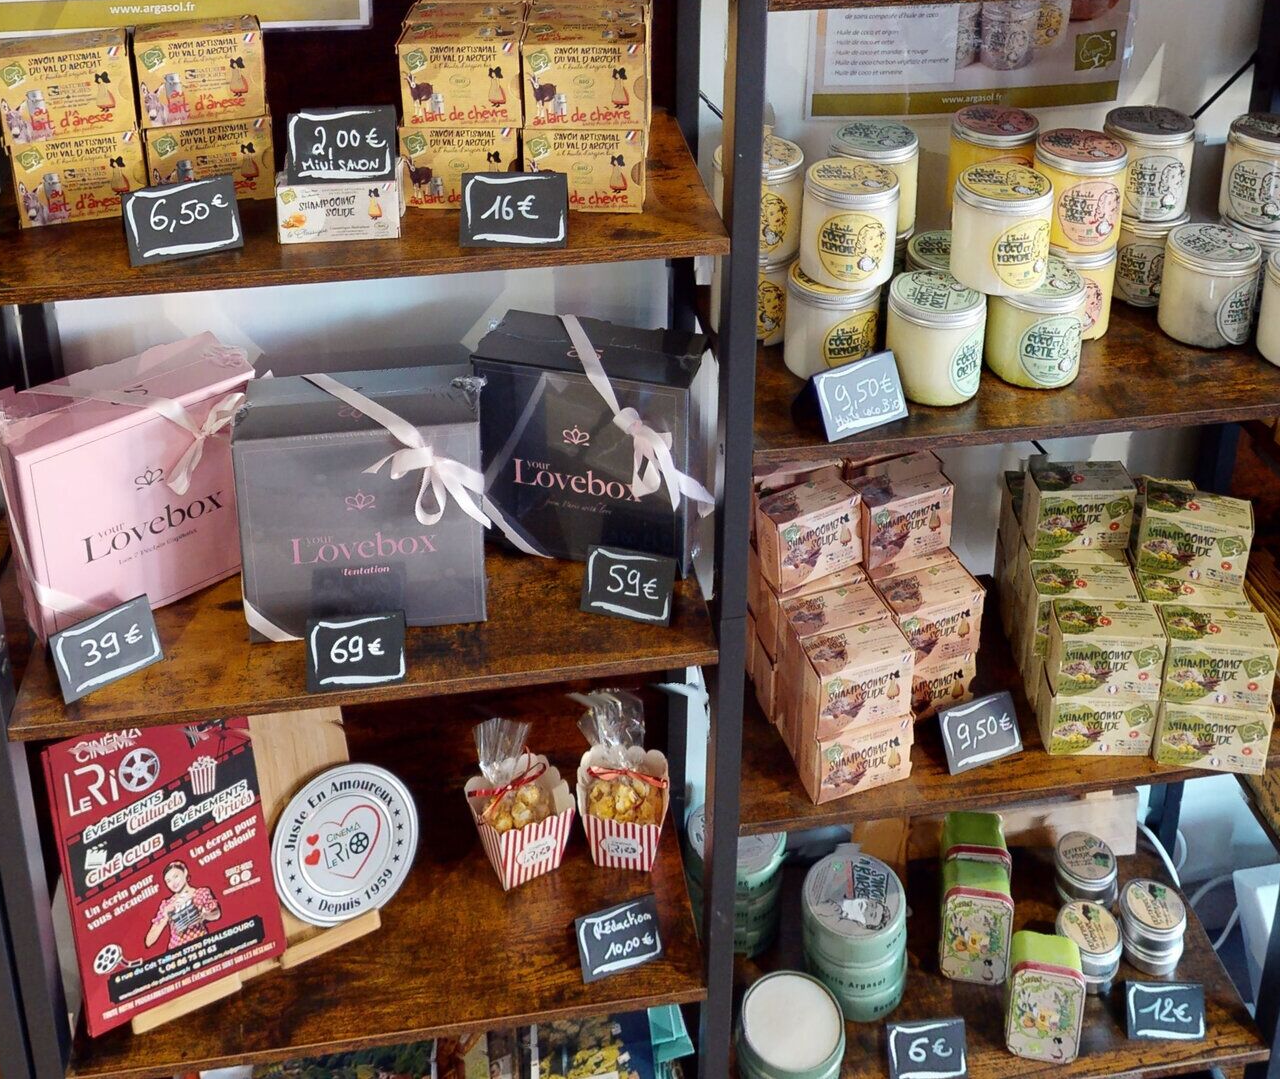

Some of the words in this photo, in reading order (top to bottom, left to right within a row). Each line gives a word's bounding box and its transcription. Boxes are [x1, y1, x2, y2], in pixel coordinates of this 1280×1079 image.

[110, 2, 195, 15] www.argasol.fr
[449, 108, 466, 122] de
[468, 106, 509, 121] chèvre
[590, 106, 631, 121] chèvre
[338, 158, 379, 171] SAVON
[1024, 344, 1054, 358] ORTIE
[513, 458, 642, 502] Lovebox
[1043, 502, 1106, 517] SHAMPOOING
[1070, 512, 1102, 525] SOLIDE
[80, 488, 227, 565] Lovebox
[1148, 526, 1216, 547] SHAMPOOING
[290, 531, 439, 566] Lovebox
[1177, 541, 1213, 558] SOLIDE
[84, 790, 164, 843] ÉVÉNEMENTS
[127, 791, 186, 834] Culturels
[171, 780, 248, 831] ÉVÉNEMENTS
[284, 810, 308, 851] Juste
[307, 790, 326, 809] En
[330, 777, 394, 808] Amoureux
[86, 853, 122, 888] CINÉ
[124, 833, 164, 867] CLUB
[318, 897, 361, 915] Depuis
[363, 868, 393, 900] 1959
[908, 1036, 955, 1063] 6€
